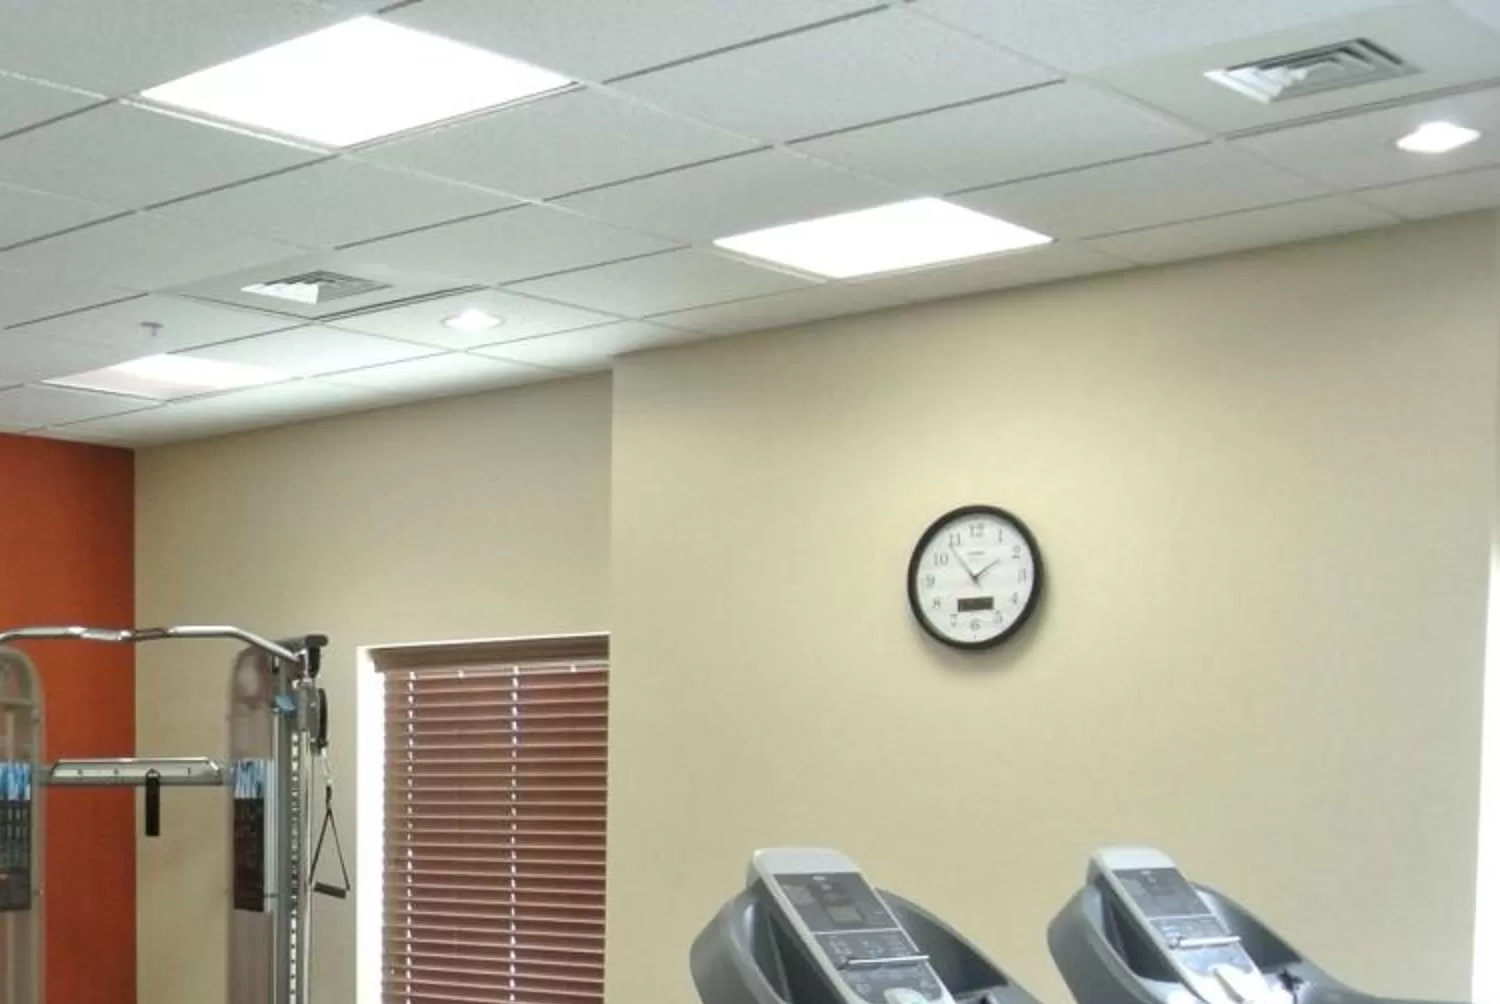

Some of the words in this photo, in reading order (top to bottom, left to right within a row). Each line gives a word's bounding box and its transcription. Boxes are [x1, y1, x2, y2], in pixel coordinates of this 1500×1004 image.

[968, 523, 985, 537] 12
[948, 533, 961, 546] 11
[934, 552, 948, 566] 10
[925, 575, 935, 588] 9
